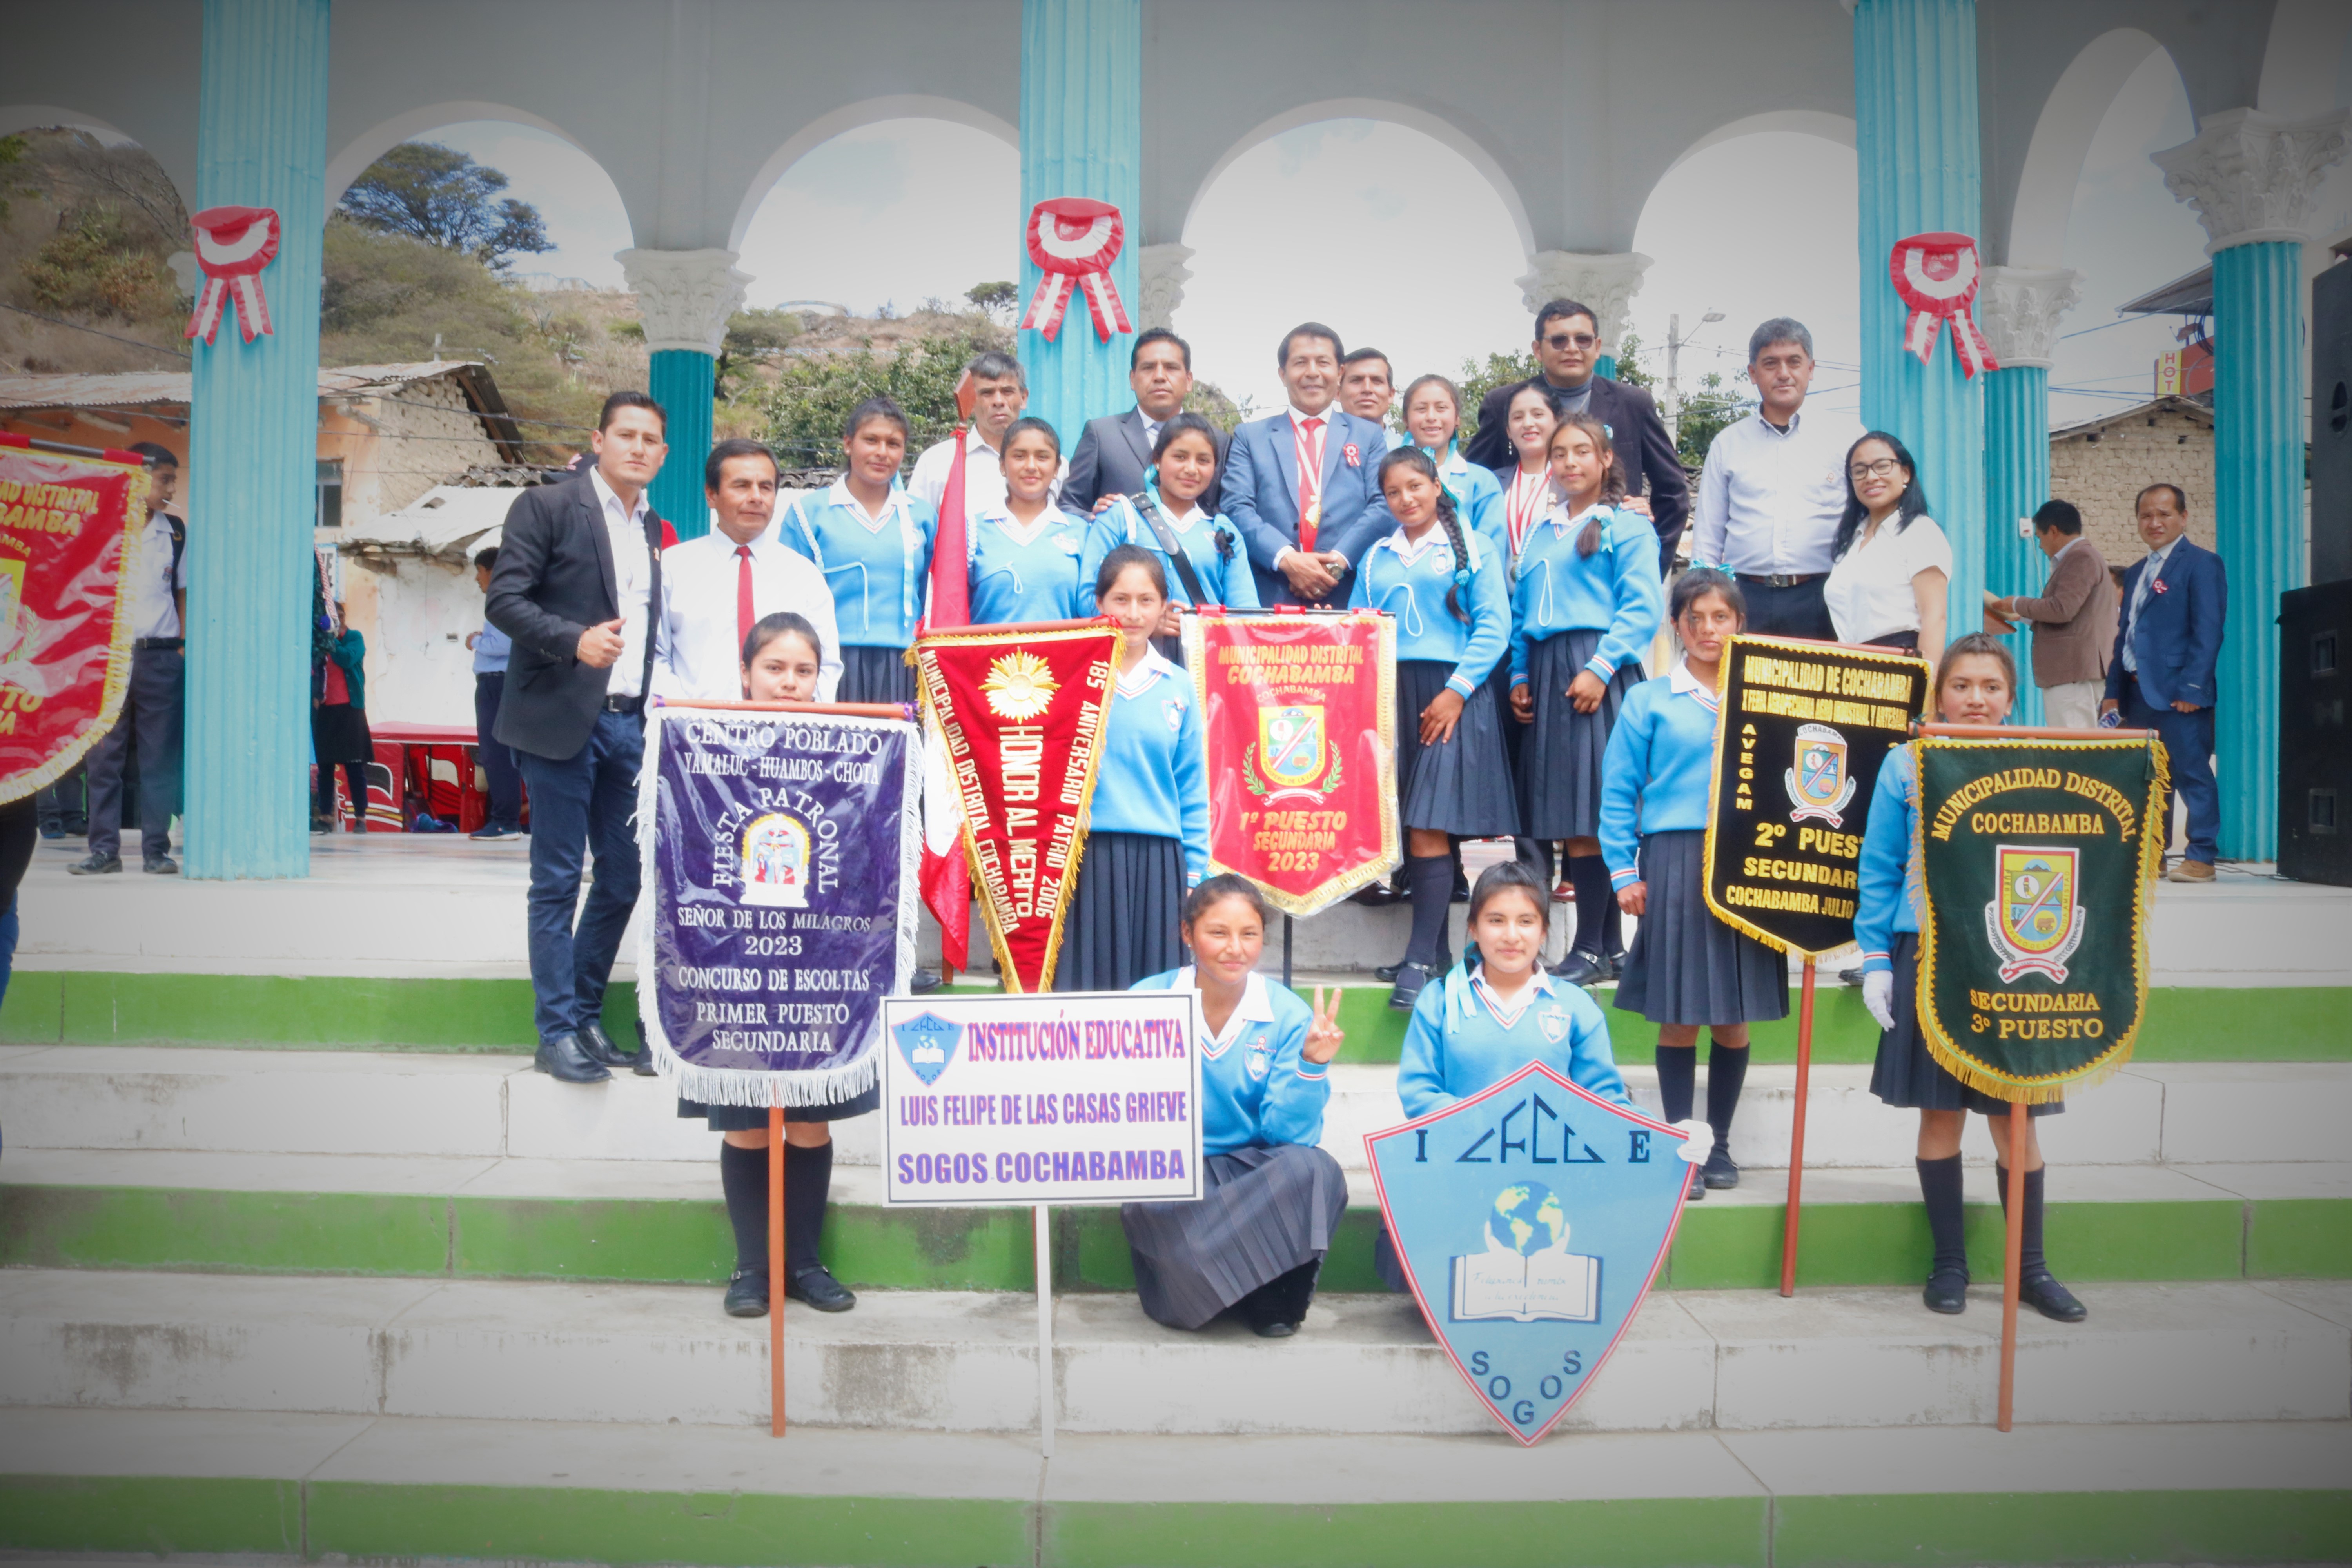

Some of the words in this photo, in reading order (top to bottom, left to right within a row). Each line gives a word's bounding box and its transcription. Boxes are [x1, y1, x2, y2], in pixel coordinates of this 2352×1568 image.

[2163, 353, 2176, 392] HOT
[23, 481, 99, 514] DISTRITAL
[0, 532, 31, 557] MBA
[1218, 645, 1308, 665] MUNICIPALIDAD
[1310, 645, 1364, 664] DISTRITAL
[1086, 659, 1110, 690] 185
[1227, 665, 1354, 685] COCHABAMBA
[1744, 655, 1825, 692] MUNICIPALIDAD
[1826, 665, 1842, 694] DE
[1842, 667, 1912, 703] COCHABAMBA
[0, 684, 44, 713] TO
[1256, 685, 1326, 703] COCHABAMBA
[685, 722, 775, 749] CENTRO
[784, 727, 882, 755] POBLADO
[1798, 725, 1844, 741] COCHABAMB
[684, 751, 749, 777] YAMALUC
[759, 757, 823, 782] HUAMBOS
[833, 761, 879, 785] CHOTA
[998, 725, 1044, 802] HONOR
[1059, 700, 1100, 806] ANIVERSARIO
[1736, 723, 1757, 810] AVEGAM
[920, 649, 970, 757] MUNICIPALIDAD
[955, 758, 991, 837] DISTRITAL
[976, 838, 1020, 935] COCHABAMBA
[1931, 768, 2062, 842] MUNICIPALIDAD
[2064, 771, 2136, 842] DISTRITAL
[1004, 806, 1038, 837] AL
[1263, 811, 1347, 831] PUESTO
[1971, 813, 2105, 835] COCHABAMBA
[712, 801, 753, 888] FIESTA
[758, 787, 839, 894] PATRONAL
[1045, 813, 1076, 869] PATRIO
[1253, 831, 1336, 851] SECUNDARIA
[1798, 827, 1864, 859] PUES
[1268, 851, 1320, 871] 2023
[1743, 857, 1859, 890] SECUNDAR
[1008, 838, 1037, 918] MERITO
[1035, 875, 1061, 920] 2006
[1726, 884, 1819, 914] COCHABAMBA
[1821, 897, 1855, 920] JULIO
[677, 904, 726, 929] SEÑOR
[733, 910, 753, 929] DE
[759, 911, 786, 930] LOS
[792, 914, 871, 933] MILAGROS
[745, 936, 802, 955] 2023
[678, 966, 762, 991] CONCURSO
[768, 968, 789, 991] DE
[794, 968, 870, 992] ESCOLTAS
[696, 1002, 769, 1025] PRIMER
[778, 1003, 850, 1025] PUESTO
[1970, 988, 2100, 1013] SECUNDARIA
[712, 1031, 832, 1053] SECUNDARIA
[968, 1009, 1080, 1062] INSTITUCIÓN
[1085, 1018, 1185, 1060] EDUCATIVA
[1998, 1018, 2104, 1040] PUESTO
[900, 1094, 938, 1126] LUIS
[944, 1093, 997, 1125] FELIPE
[1001, 1094, 1022, 1125] DE
[1027, 1093, 1058, 1125] LAS
[1063, 1092, 1121, 1124] CASAS
[1126, 1091, 1187, 1123] GRIEVE
[898, 1152, 989, 1185] SOGOS
[996, 1149, 1185, 1183] COCHABAMBA
